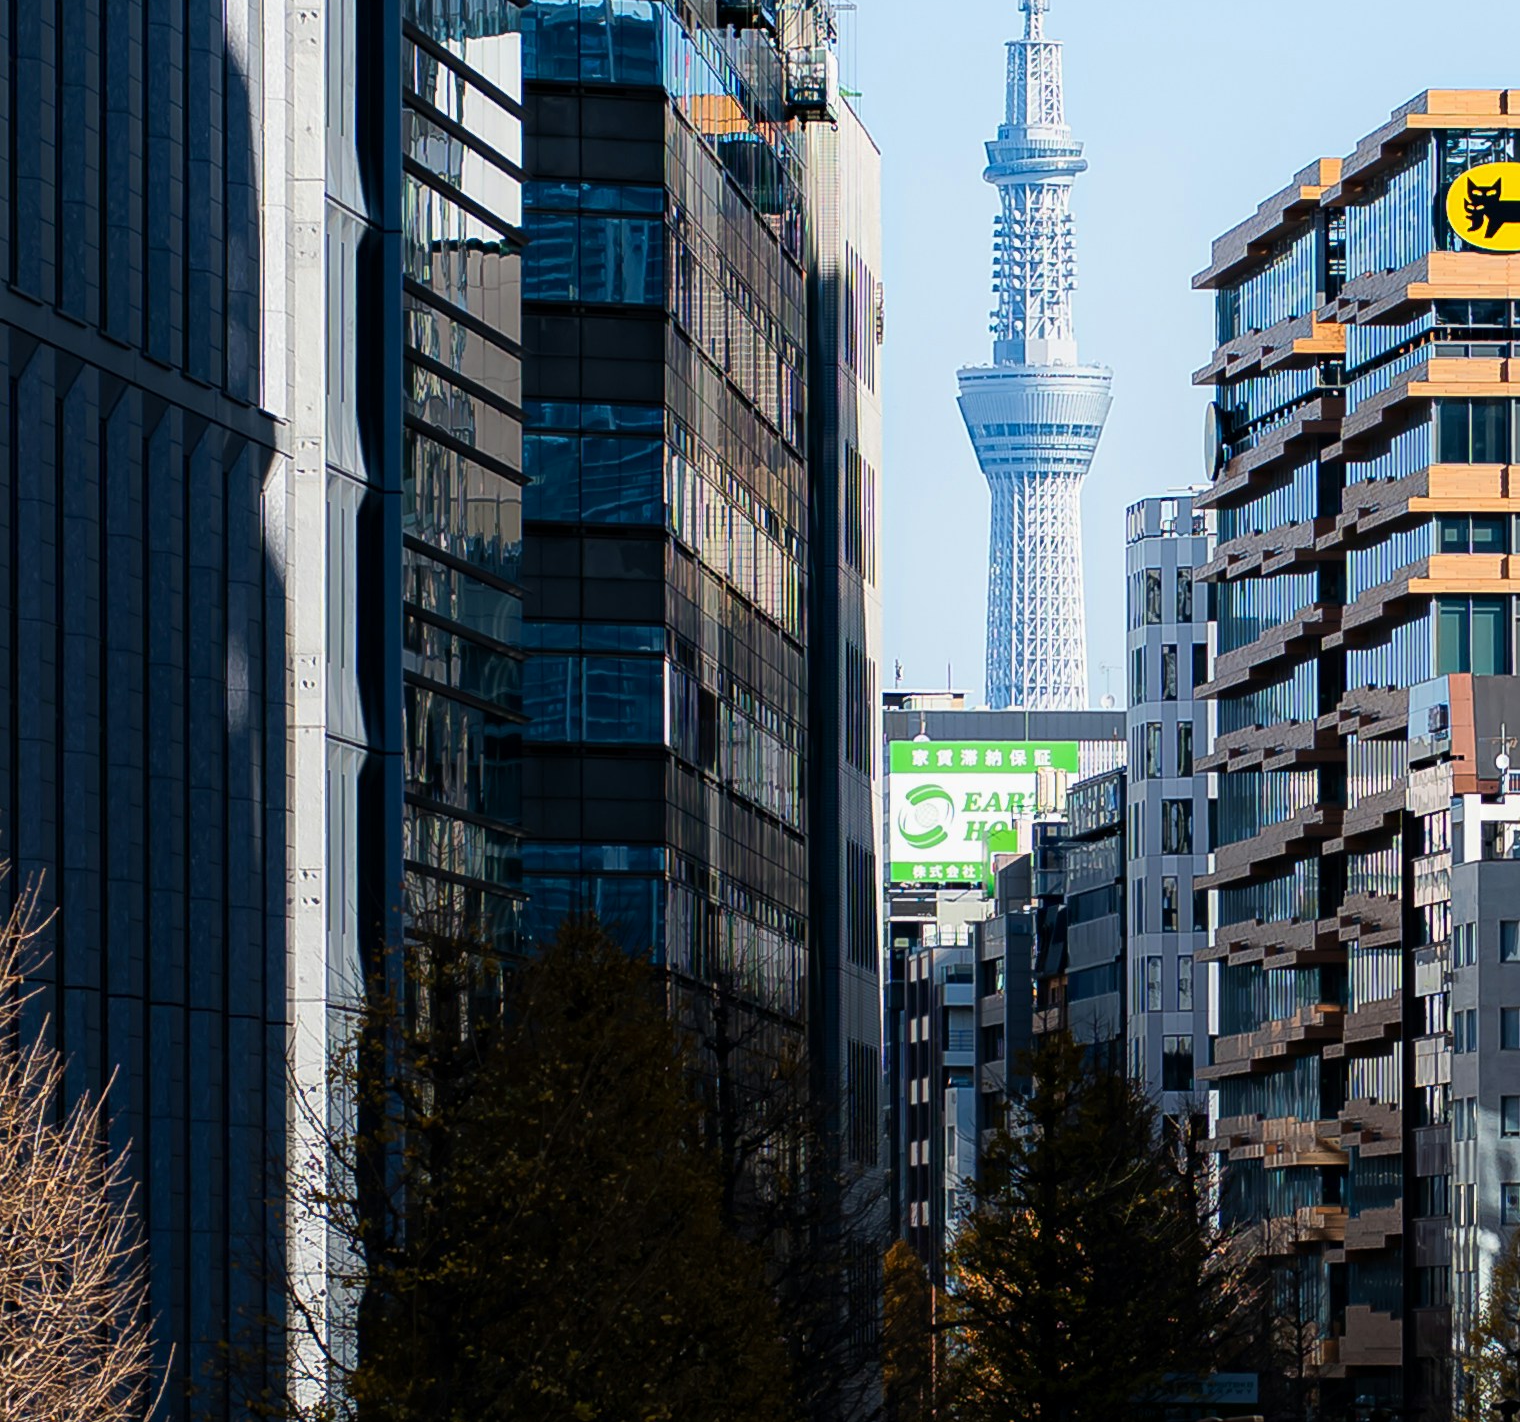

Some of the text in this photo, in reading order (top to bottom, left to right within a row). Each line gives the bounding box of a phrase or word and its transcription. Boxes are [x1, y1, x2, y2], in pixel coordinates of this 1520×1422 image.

[912, 749, 1052, 766] 家賃滞納保証
[912, 864, 983, 879] 株式会社
